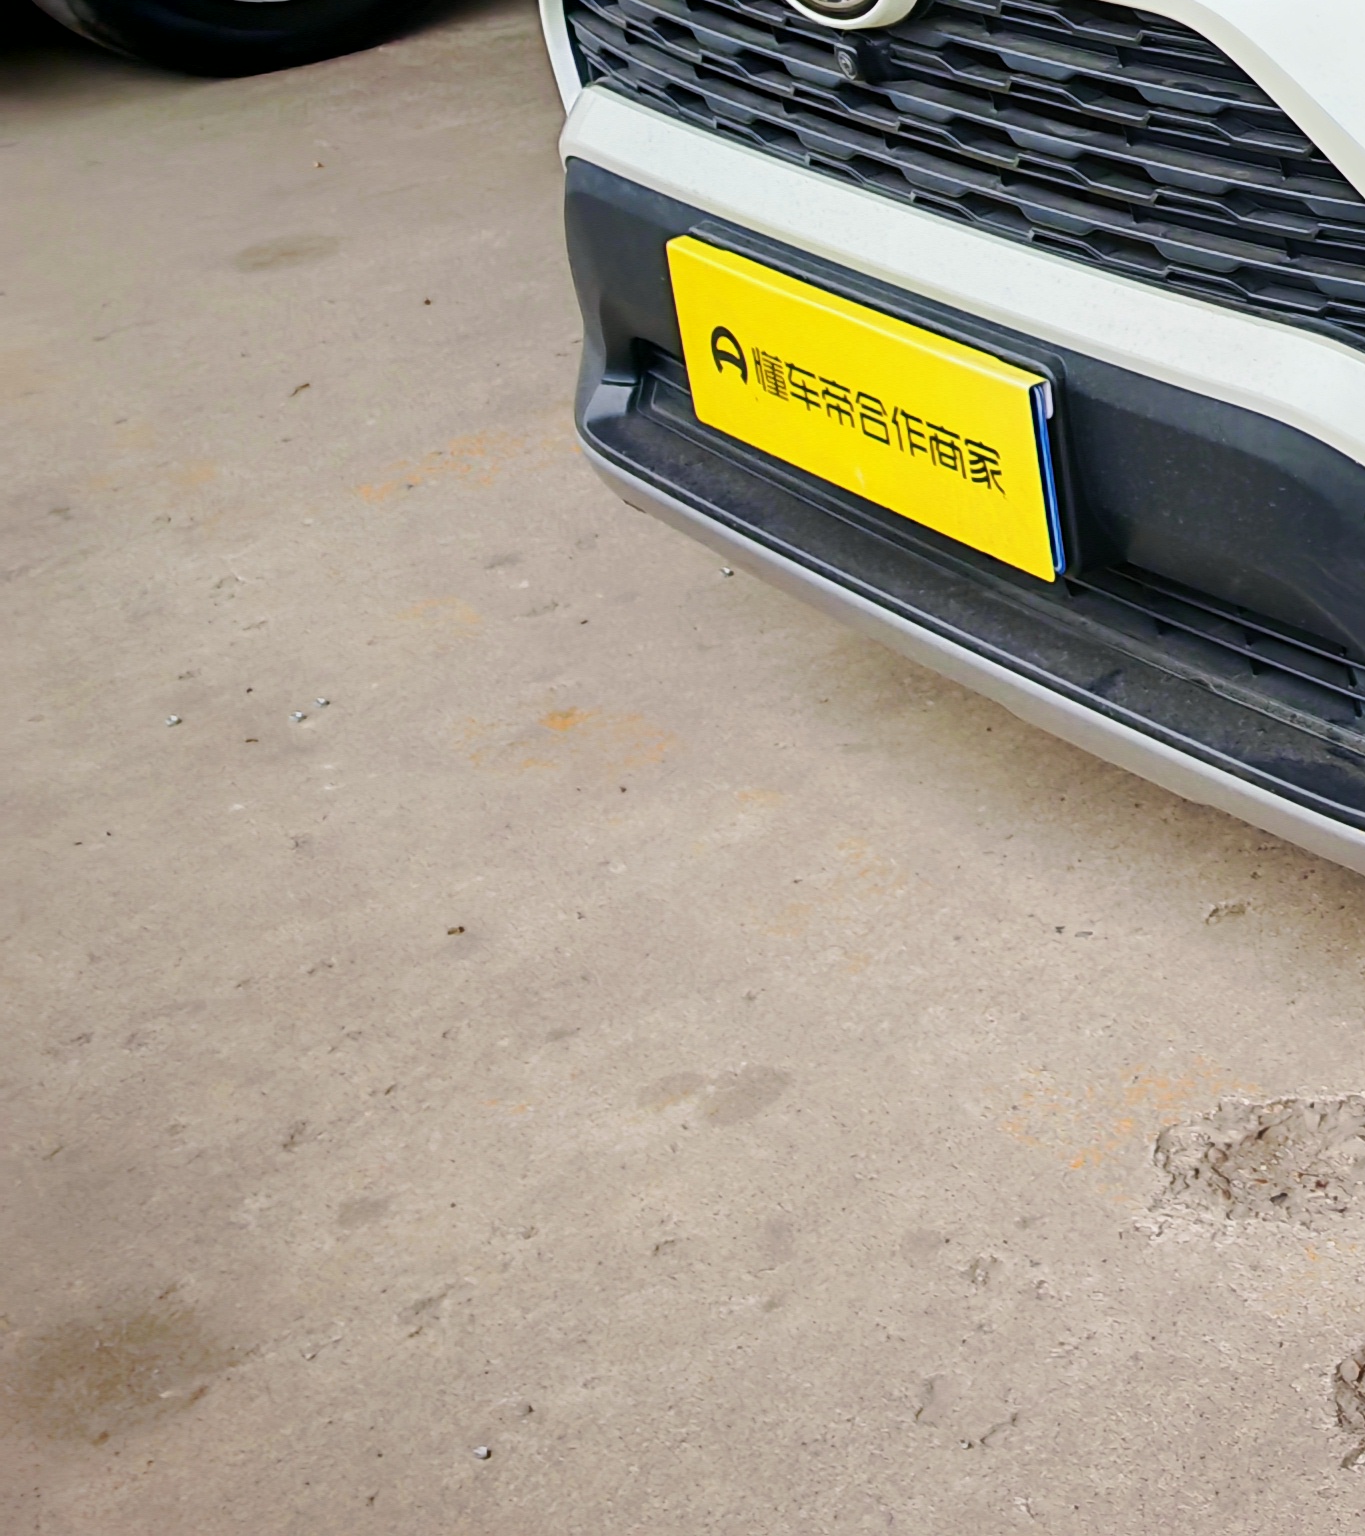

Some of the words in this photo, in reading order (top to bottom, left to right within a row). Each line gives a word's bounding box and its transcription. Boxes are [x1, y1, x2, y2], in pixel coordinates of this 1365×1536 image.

[751, 345, 1006, 495] 懂车帝合作商家
